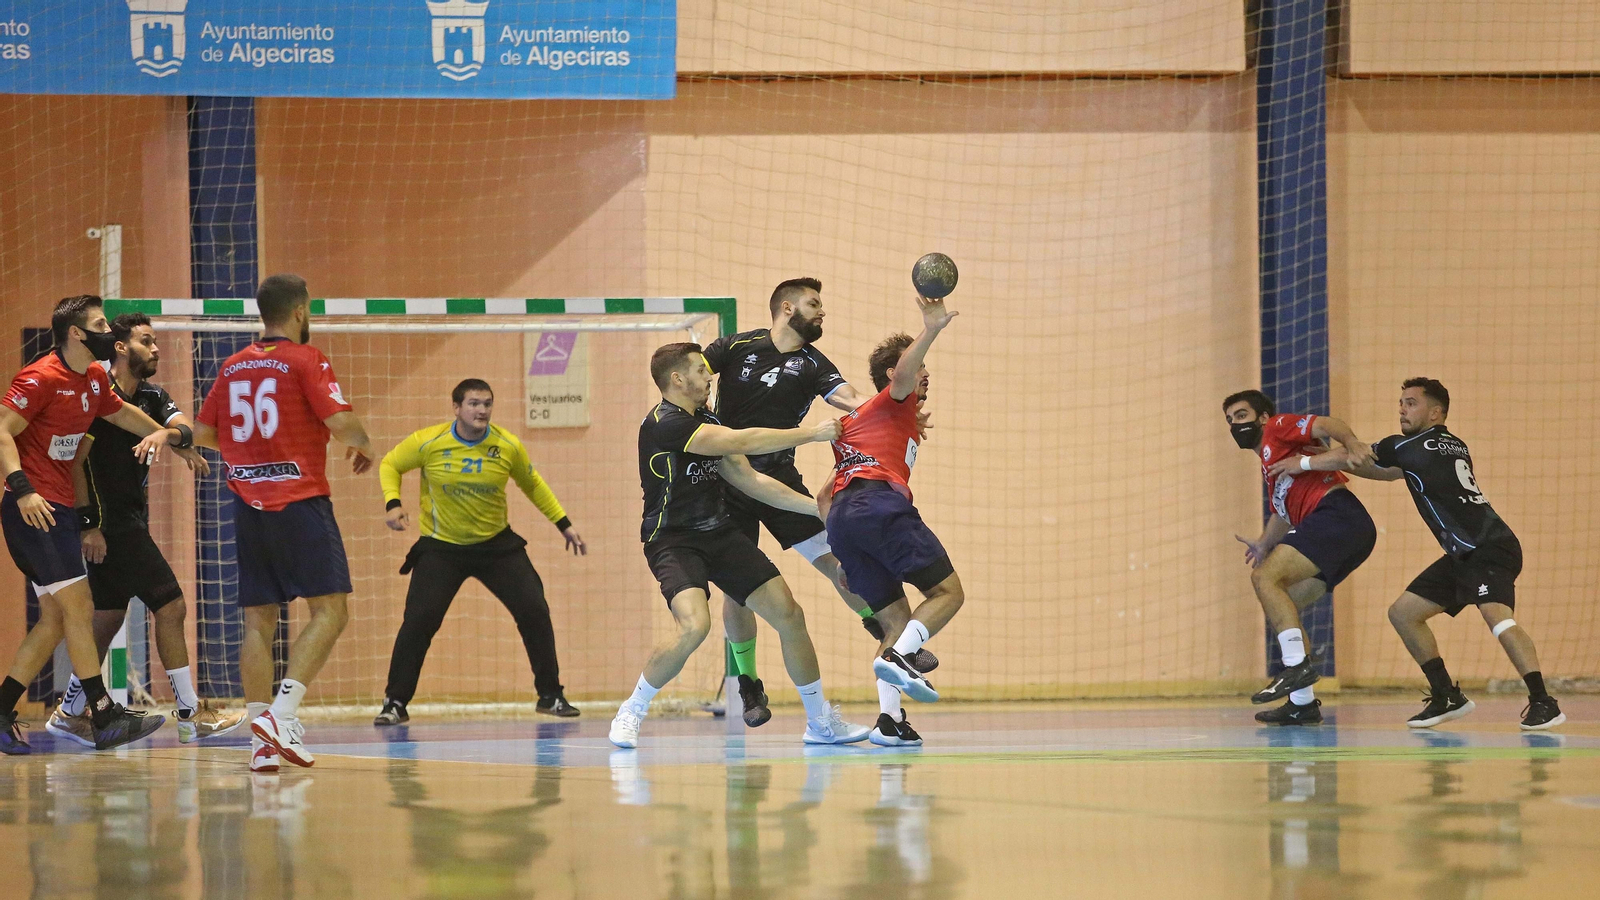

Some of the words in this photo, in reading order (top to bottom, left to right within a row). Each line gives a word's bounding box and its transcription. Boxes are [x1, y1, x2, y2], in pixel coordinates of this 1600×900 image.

[200, 21, 334, 44] Ayuntamiento
[499, 24, 630, 48] Ayuntamiento
[201, 46, 224, 62] de
[228, 42, 335, 68] Algeciras
[500, 49, 521, 66] de
[526, 45, 630, 71] Algeciras
[760, 366, 780, 388] 4
[80, 392, 89, 412] 6
[228, 377, 279, 443] 56
[529, 393, 583, 404] Vestuarios
[460, 457, 483, 474] 21
